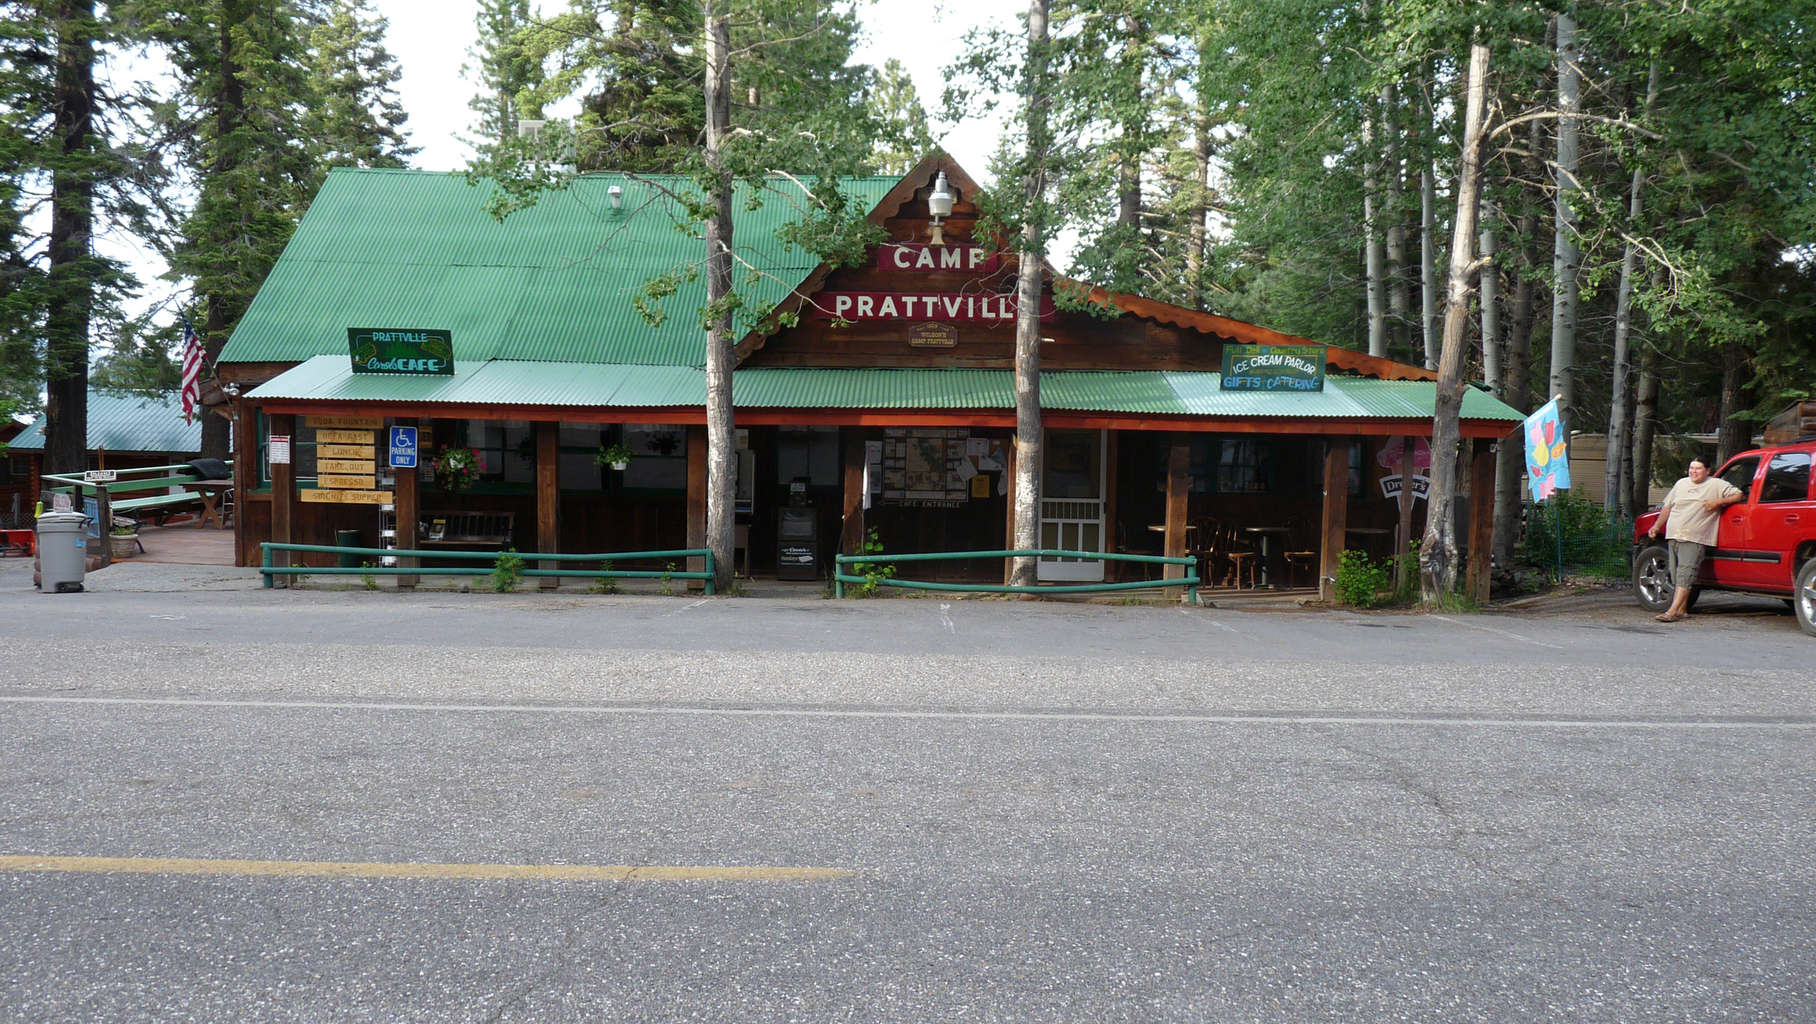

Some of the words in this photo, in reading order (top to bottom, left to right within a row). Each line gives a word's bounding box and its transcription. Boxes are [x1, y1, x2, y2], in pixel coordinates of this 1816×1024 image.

[893, 247, 986, 269] CAMP
[836, 295, 1016, 318] PRATTVILL
[372, 332, 428, 342] PRATTVILLE
[398, 358, 439, 371] CAFE
[1232, 361, 1250, 375] ICE
[1250, 355, 1282, 367] CREAM
[1284, 355, 1316, 375] PARLOR
[1223, 376, 1261, 388] GIFTS
[391, 447, 416, 456] PARKING
[395, 456, 411, 465] ONLY
[1386, 481, 1426, 492] Drr's
